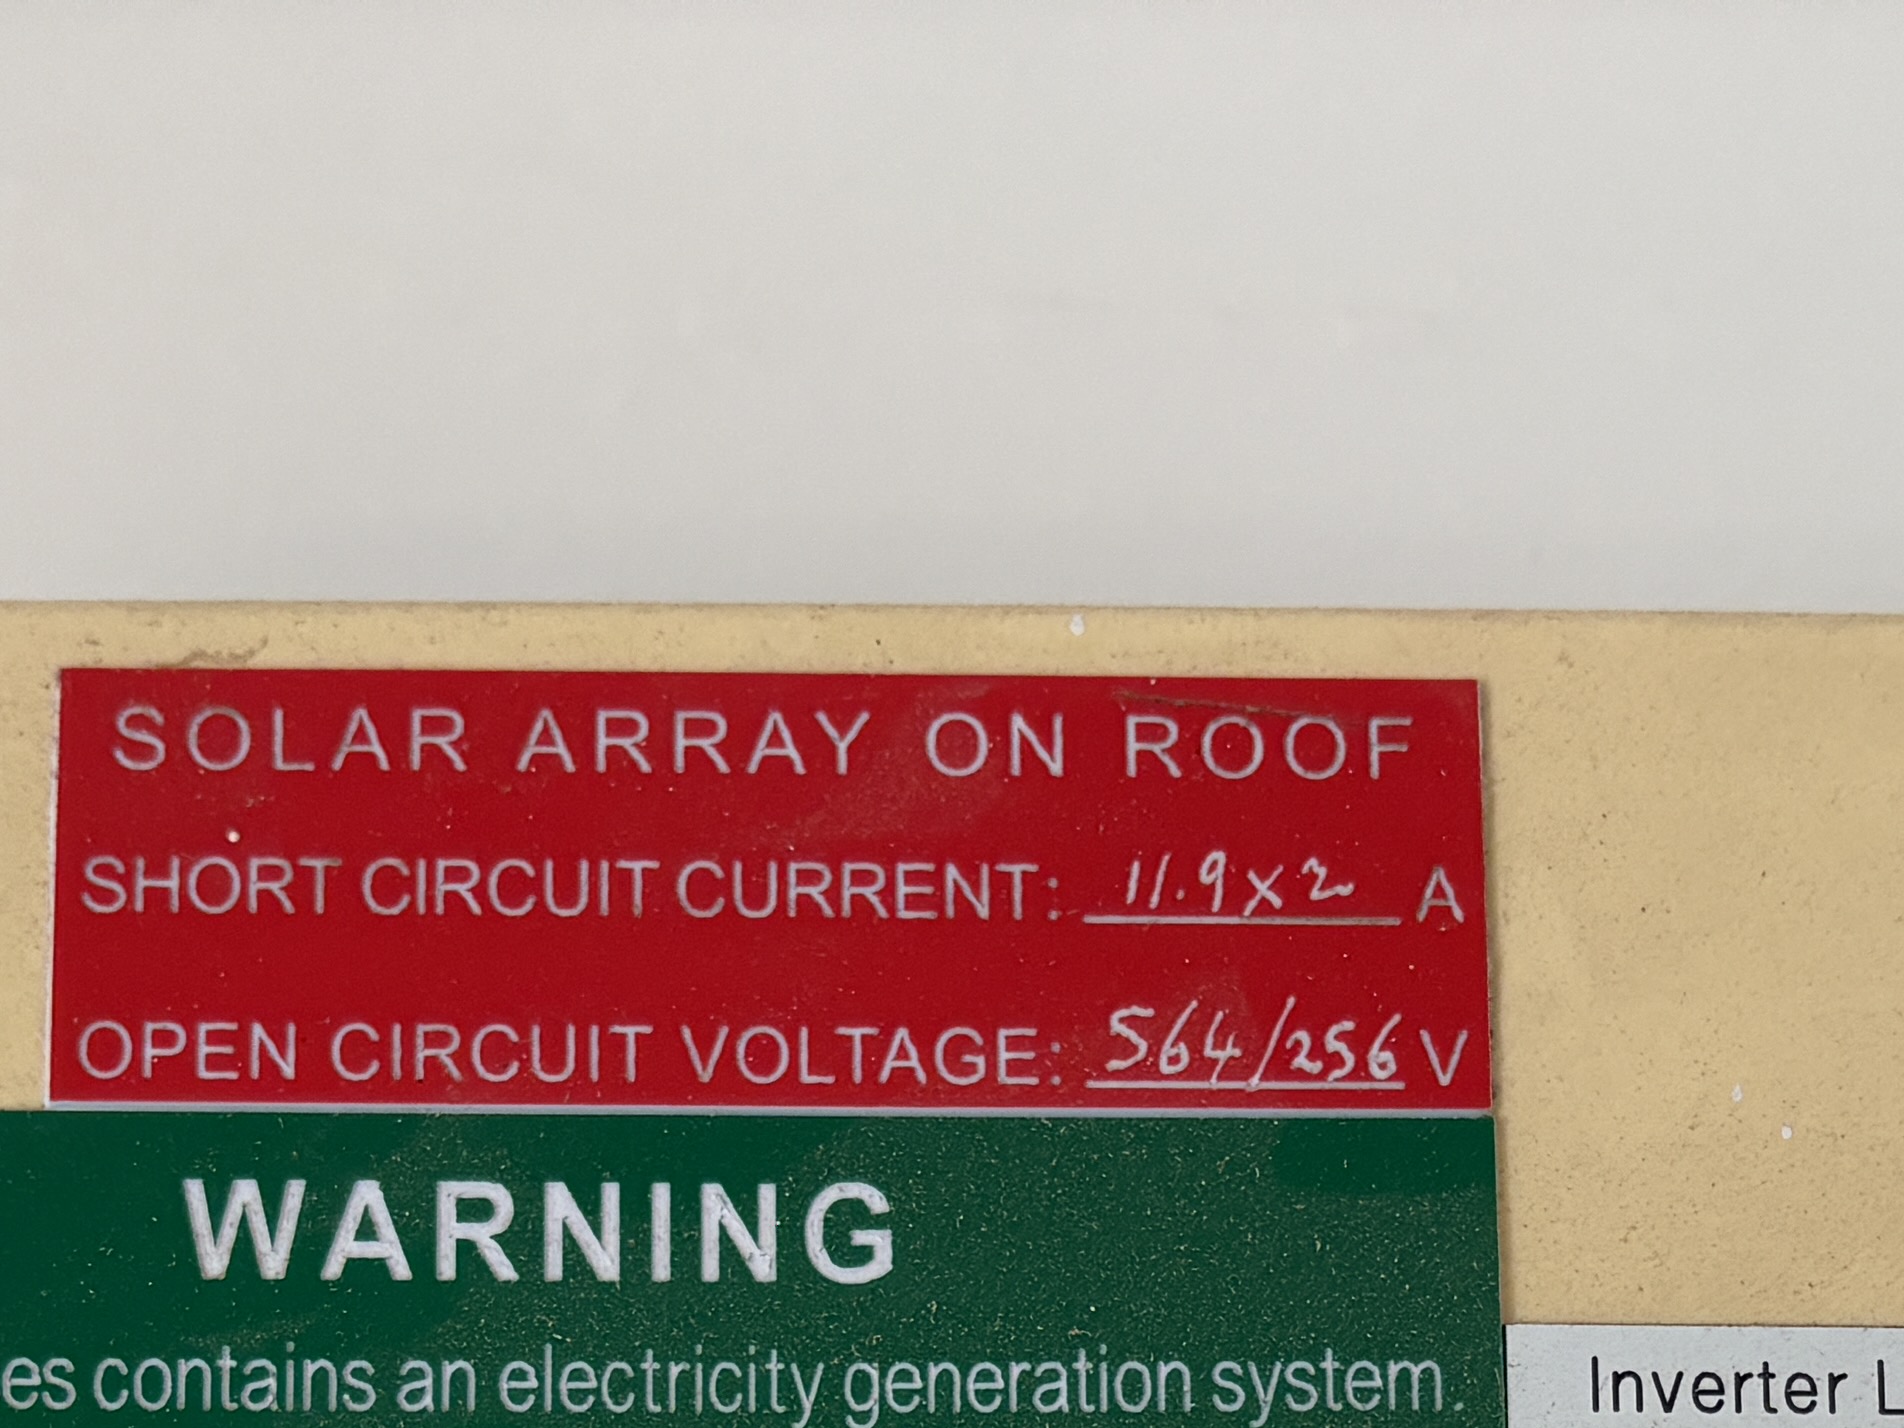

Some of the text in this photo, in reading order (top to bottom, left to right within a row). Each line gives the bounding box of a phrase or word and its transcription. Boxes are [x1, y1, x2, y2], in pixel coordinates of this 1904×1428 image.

[112, 708, 1412, 780] SOLAR ARRAY ON ROOF
[80, 854, 1062, 922] SHORT CIRCUIT CURRENT:
[1417, 865, 1464, 924] A
[77, 1020, 1062, 1088] OPEN CIRCUIT VOLTAGE:
[1420, 1029, 1467, 1087] V
[181, 1179, 897, 1283] WARNING
[95, 1345, 375, 1415] contains
[396, 1357, 478, 1415] an
[498, 1345, 824, 1423] electricity
[842, 1348, 1194, 1425] generation
[1211, 1357, 1466, 1428] system.
[1589, 1355, 1847, 1414] Inverter
